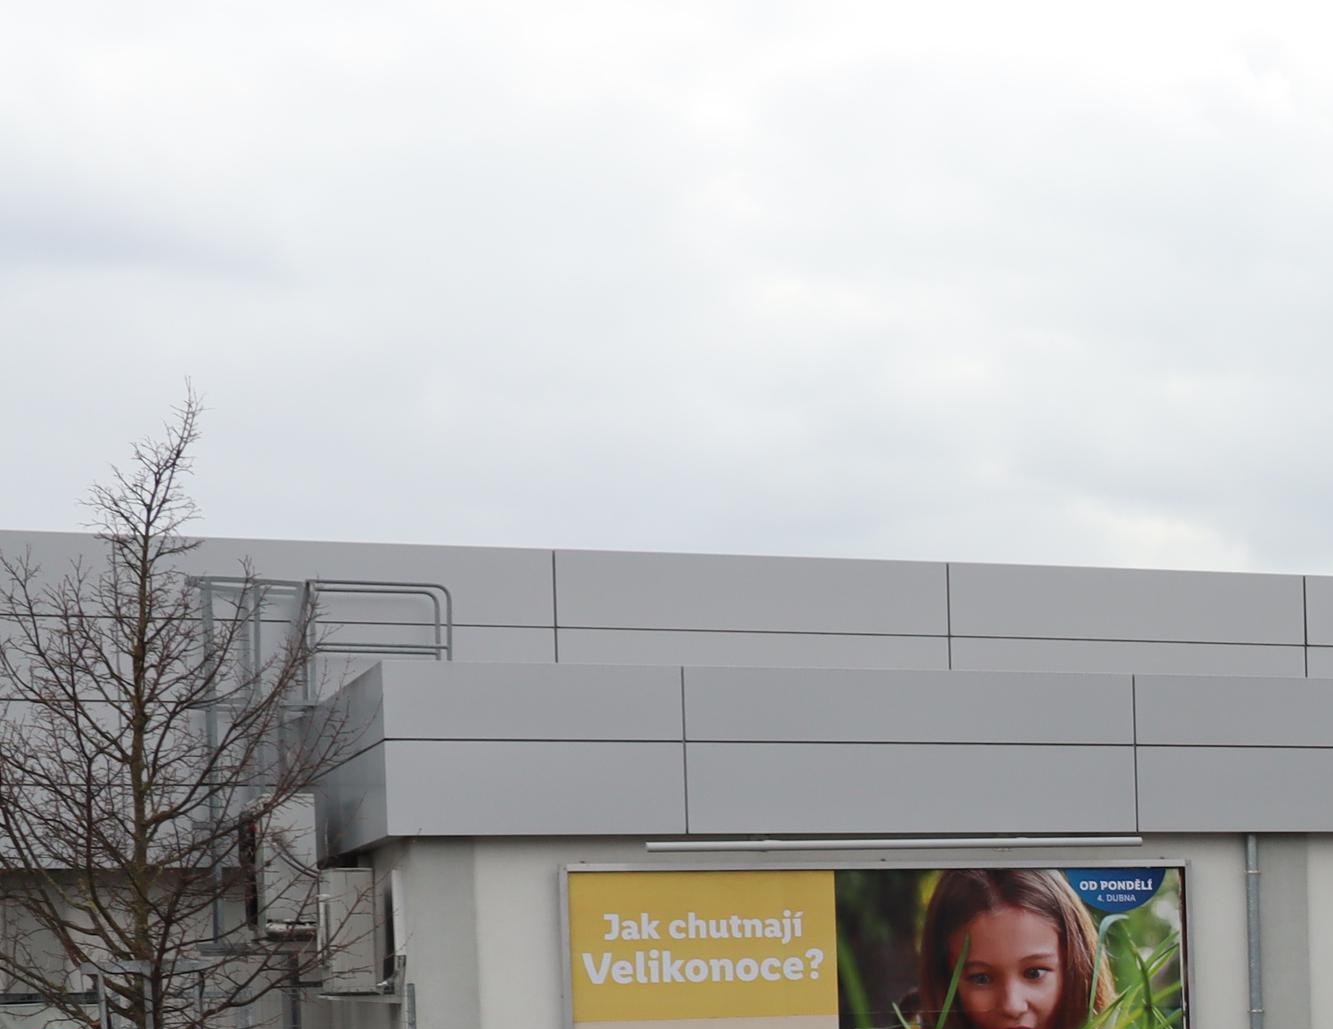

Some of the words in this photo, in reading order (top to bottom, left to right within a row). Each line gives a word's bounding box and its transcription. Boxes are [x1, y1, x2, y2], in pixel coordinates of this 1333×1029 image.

[1080, 881, 1098, 890] OD
[1100, 879, 1153, 890] PONDĚLÍ
[1106, 894, 1136, 902] DUBNA
[603, 912, 661, 941] Jak
[669, 910, 804, 944] chutnají
[582, 948, 824, 984] Velikonoce?
